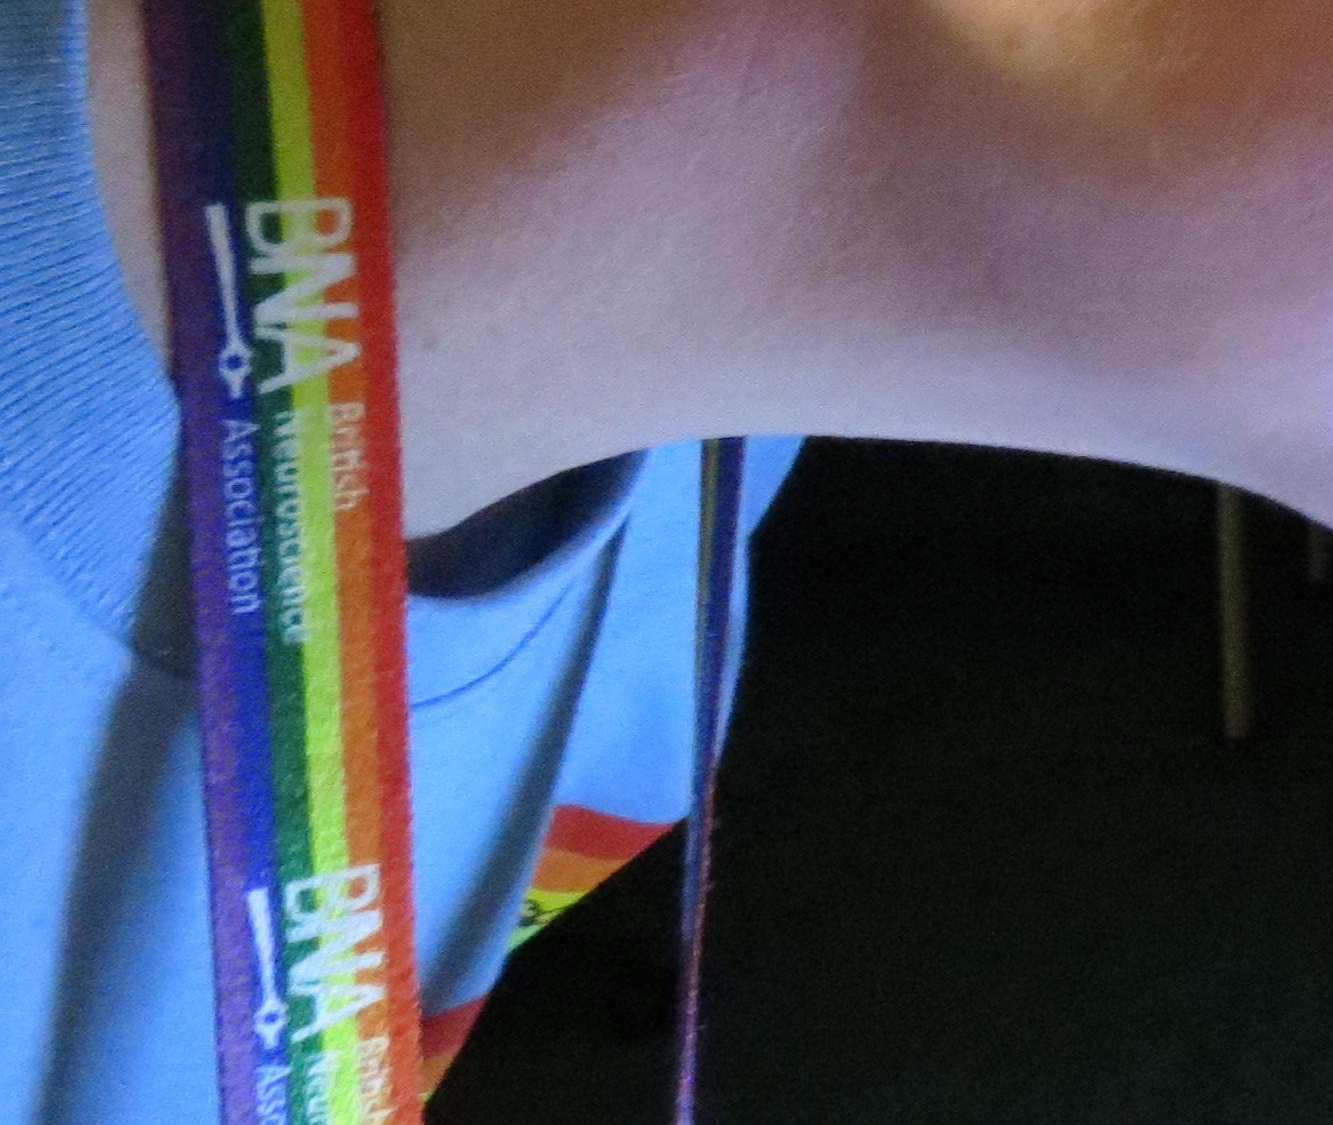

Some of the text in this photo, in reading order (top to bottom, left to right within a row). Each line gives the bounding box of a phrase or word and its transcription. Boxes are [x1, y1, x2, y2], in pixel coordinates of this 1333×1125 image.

[246, 197, 361, 394] BNA
[221, 418, 265, 615] Association
[273, 406, 312, 645] Neuroscience
[328, 401, 369, 512] British
[282, 863, 388, 1044] BNA
